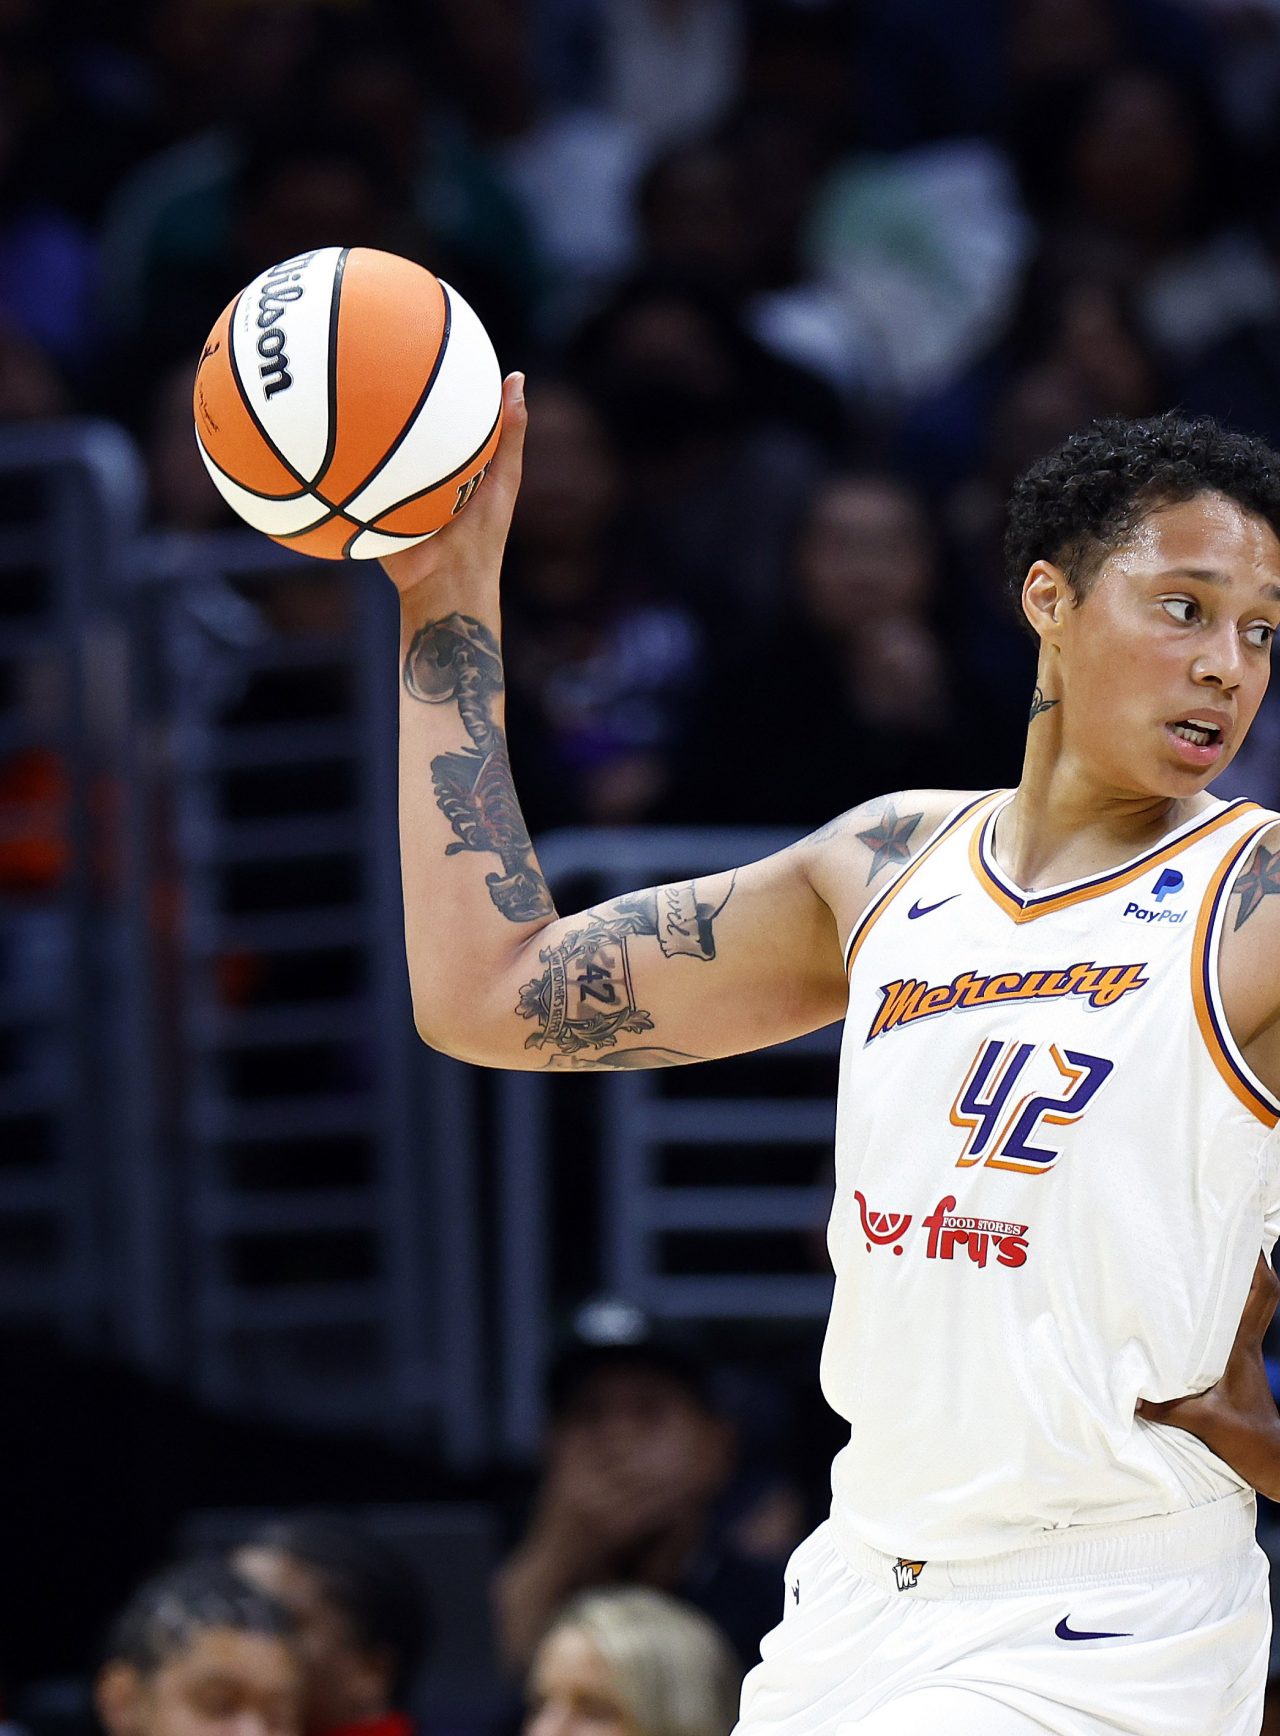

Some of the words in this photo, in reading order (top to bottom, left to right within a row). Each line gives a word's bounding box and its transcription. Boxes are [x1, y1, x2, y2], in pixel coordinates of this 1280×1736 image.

[1123, 902, 1188, 923] PayPal
[577, 963, 615, 1004] 42
[864, 961, 1150, 1046] Mercury
[949, 1039, 1116, 1175] 42
[922, 1195, 1030, 1269] fry's
[943, 1217, 976, 1229] FOOD
[977, 1220, 1021, 1236] STORES
